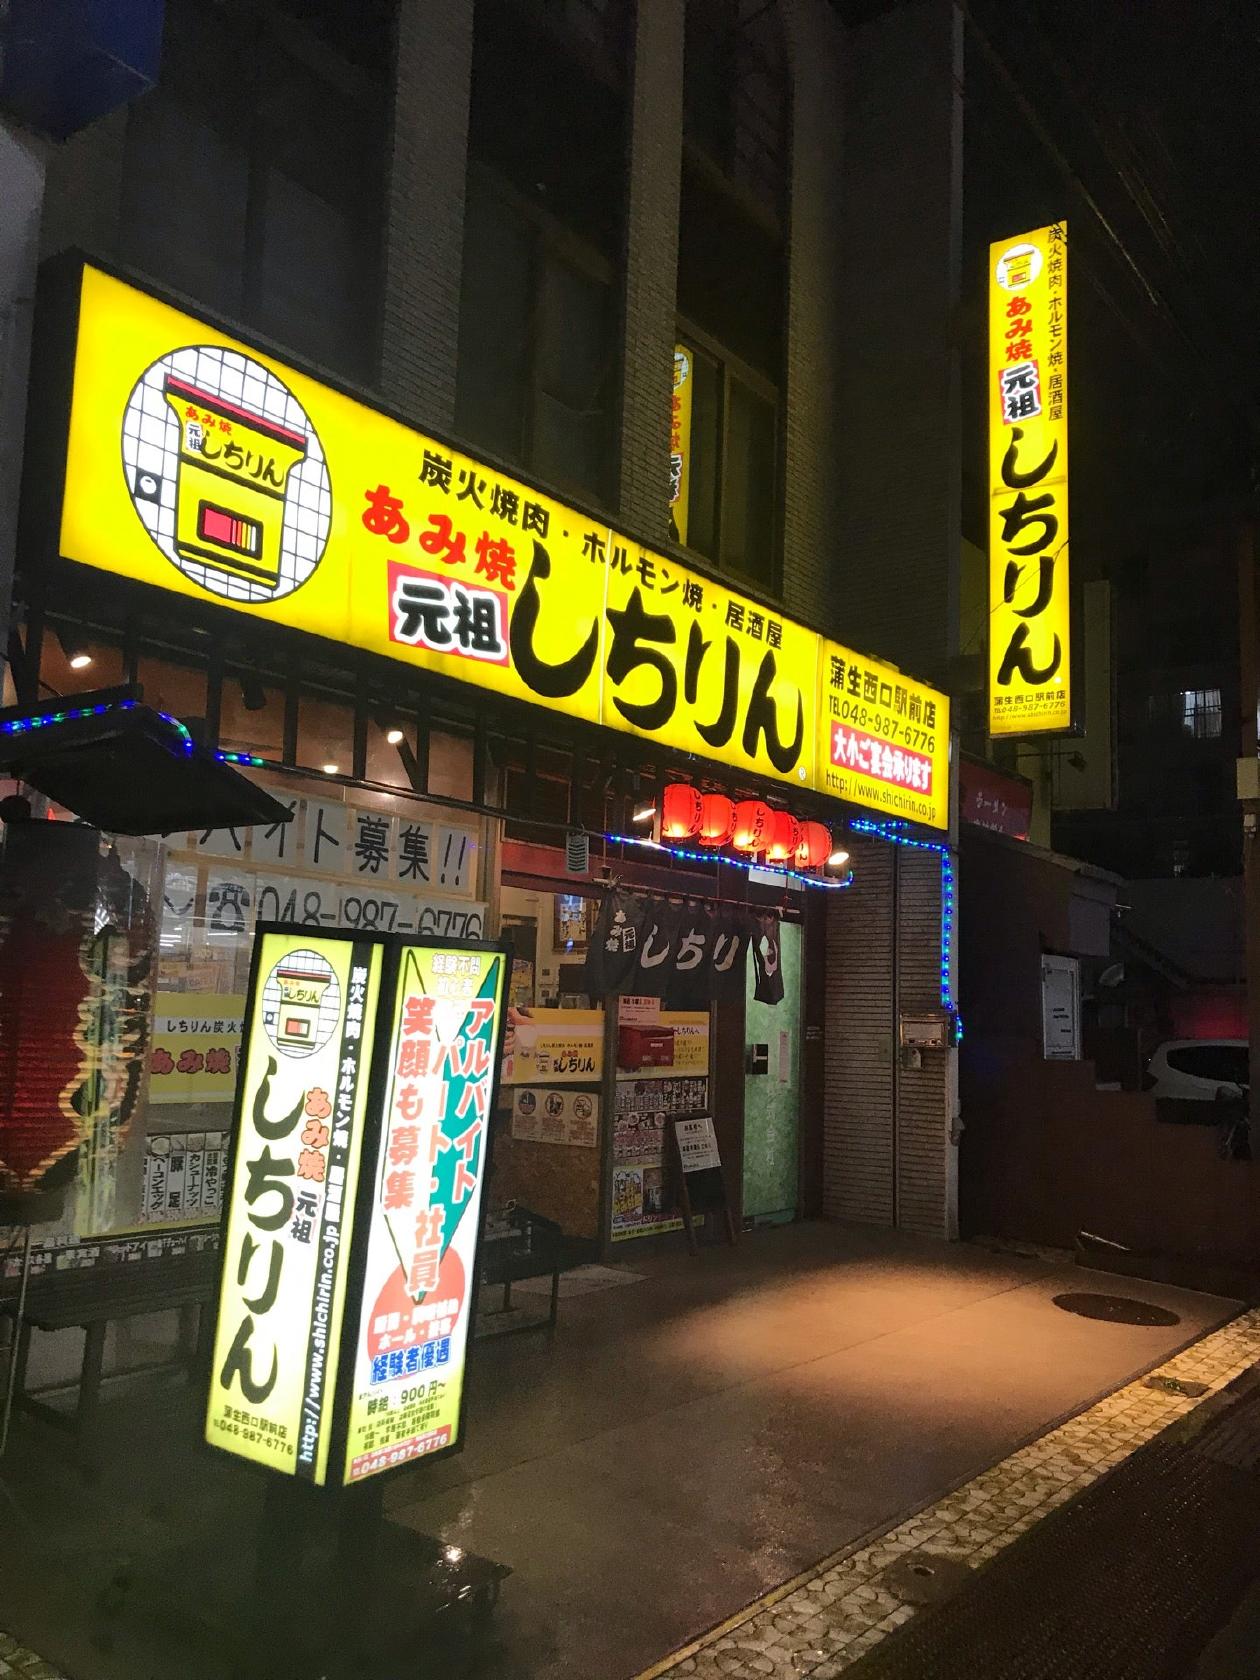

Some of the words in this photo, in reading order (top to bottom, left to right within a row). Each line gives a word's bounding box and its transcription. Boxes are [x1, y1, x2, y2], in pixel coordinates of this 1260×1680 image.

[1005, 296, 1032, 361] あみ焼
[185, 406, 232, 435] あみ焼
[1004, 364, 1039, 419] 元祖
[187, 422, 203, 451] 元祖
[201, 433, 286, 487] しちりん
[362, 485, 516, 591] あみ焼
[997, 426, 1062, 686] しちりん
[397, 583, 504, 655] 元祖
[509, 538, 804, 773] しちりん
[830, 656, 937, 730] 蒲生西口駅前店
[833, 727, 932, 792] 大小ご宴会承ります
[748, 808, 765, 847] しちりん
[287, 988, 320, 1004] しちりん
[384, 996, 437, 1211] 笑顔も募集
[453, 998, 495, 1203] アルバイト
[220, 1054, 306, 1405] しちりん
[290, 1190, 318, 1244] 元祖
